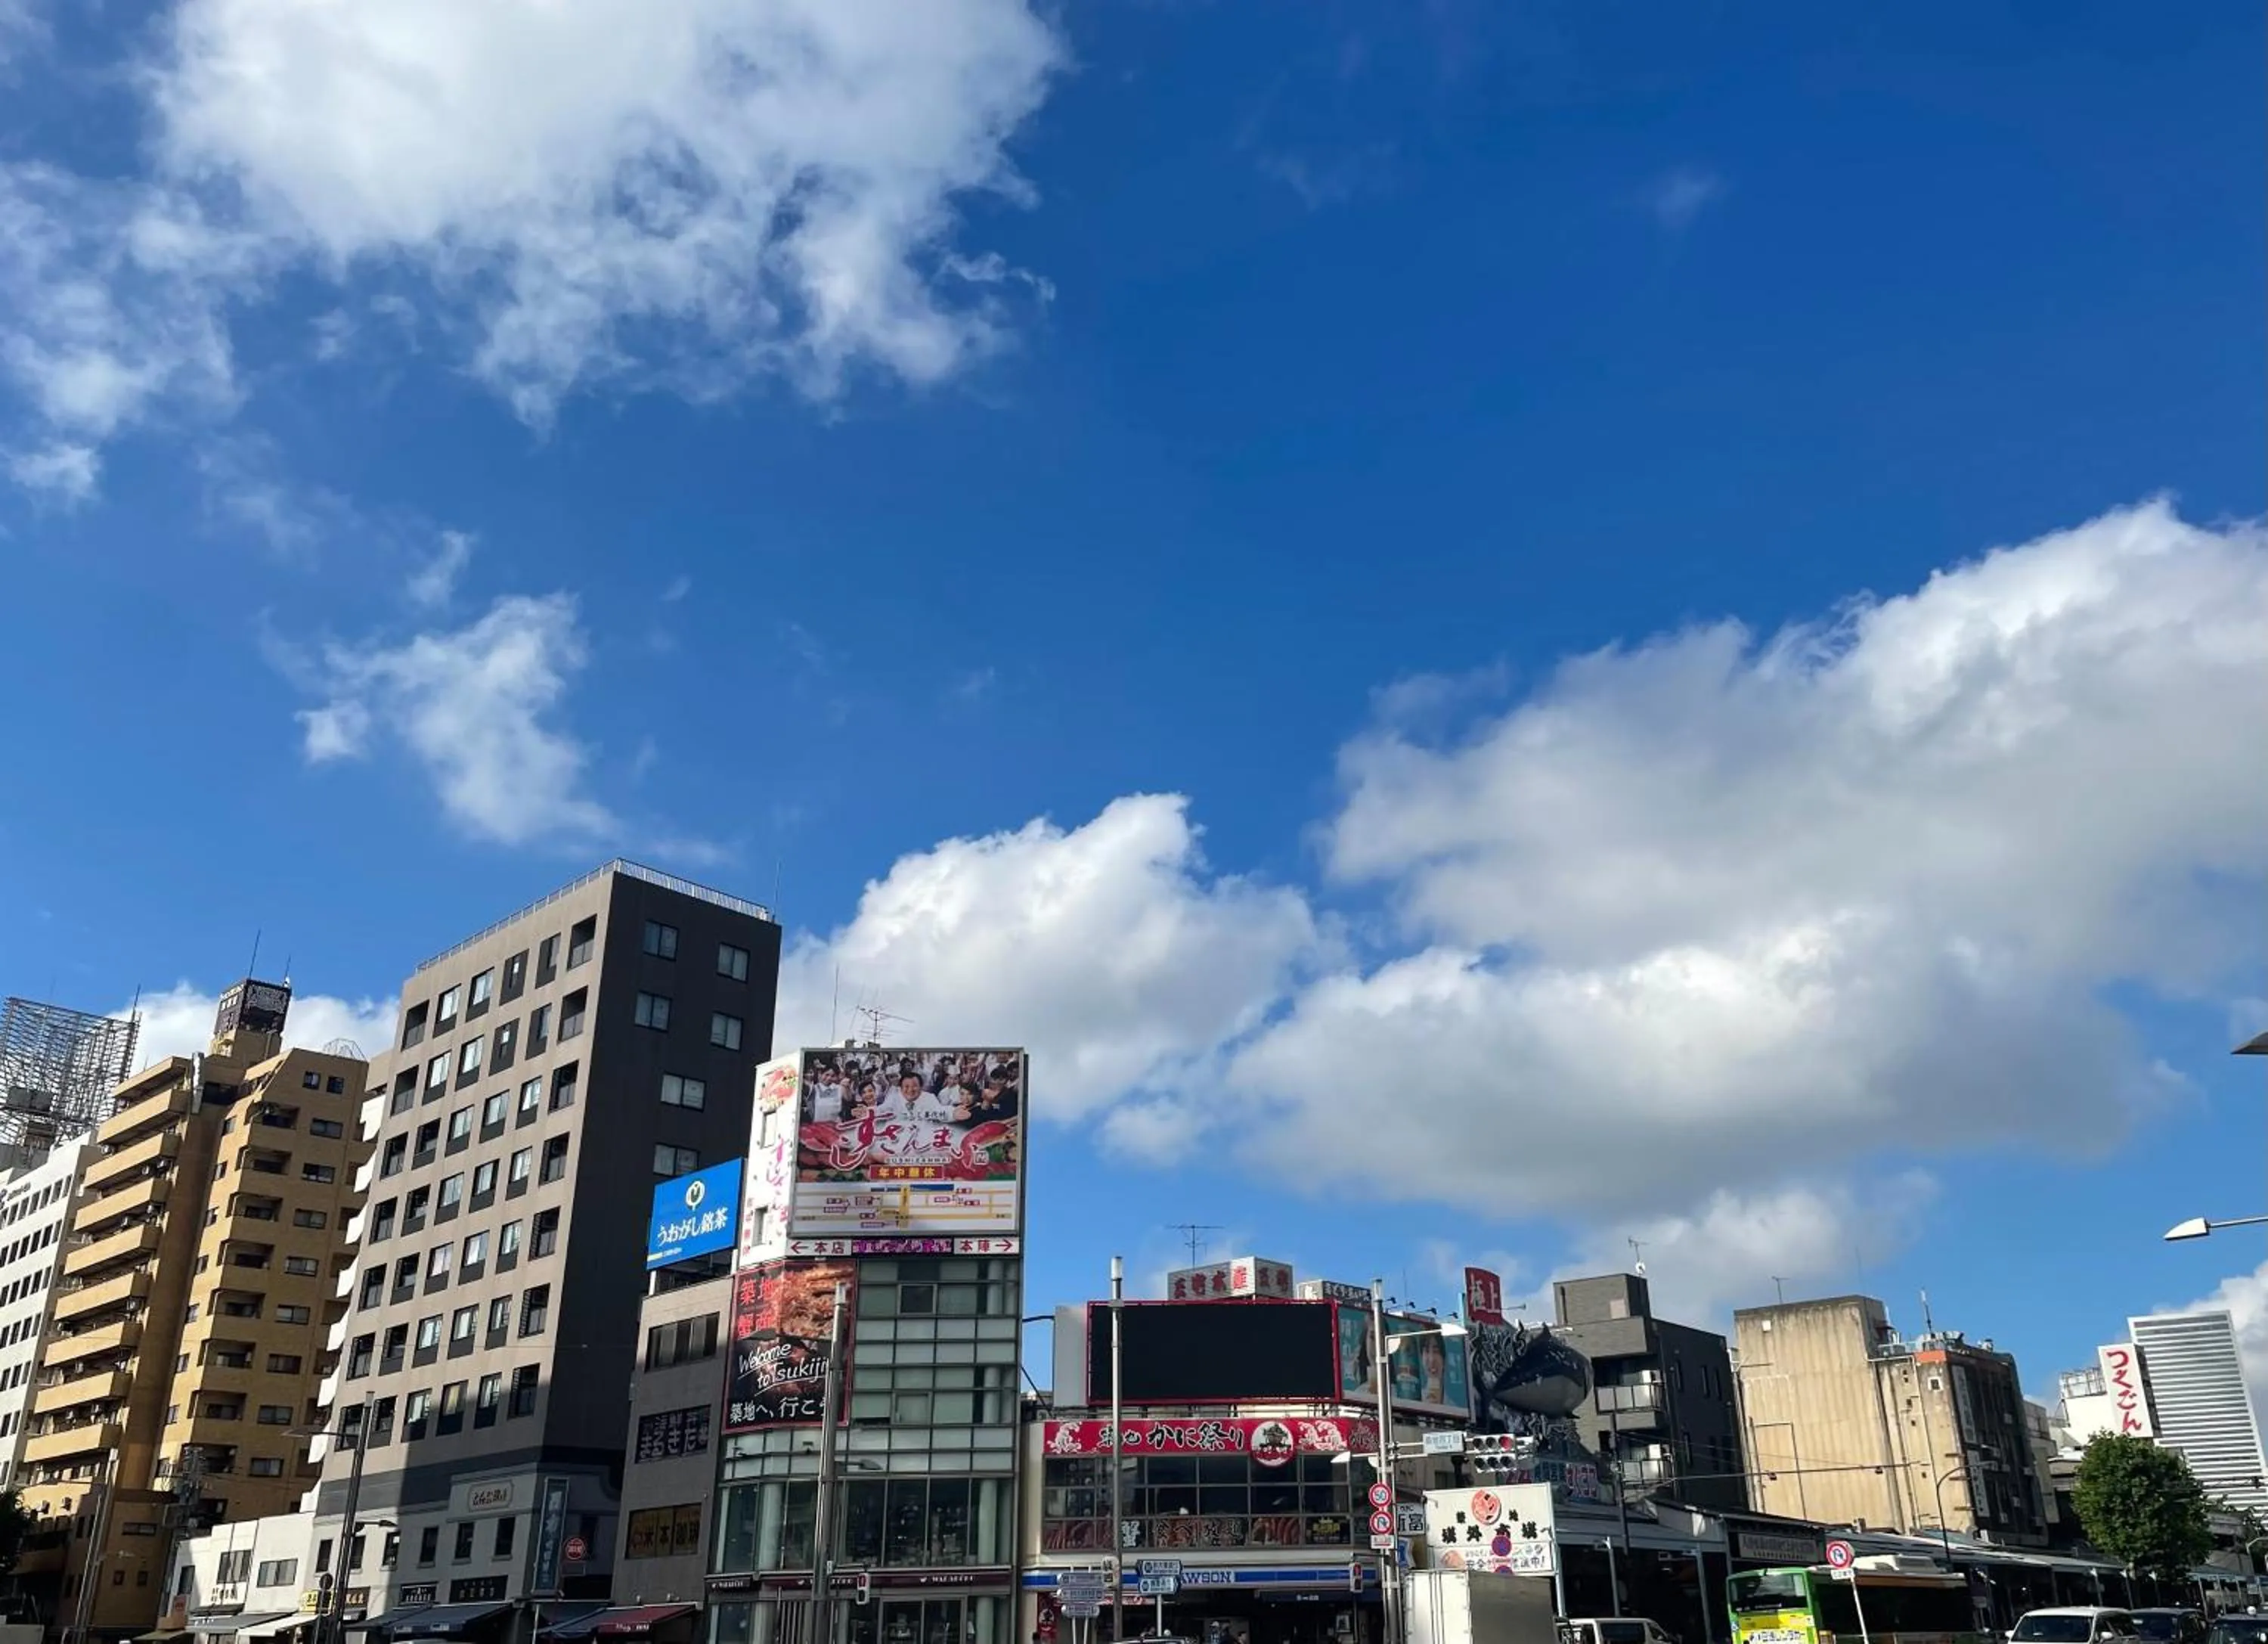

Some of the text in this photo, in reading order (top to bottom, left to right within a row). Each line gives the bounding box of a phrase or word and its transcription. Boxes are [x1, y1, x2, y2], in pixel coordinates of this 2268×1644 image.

[657, 1207, 729, 1247] うおがし銘茶
[814, 1241, 844, 1255] 本店
[959, 1239, 990, 1252] 本陣
[1469, 1273, 1501, 1314] 極上
[739, 1343, 792, 1374] Welcome
[770, 1357, 827, 1384] Tsukiji
[2106, 1351, 2142, 1432] つくごん
[1181, 1571, 1232, 1584] WSON
